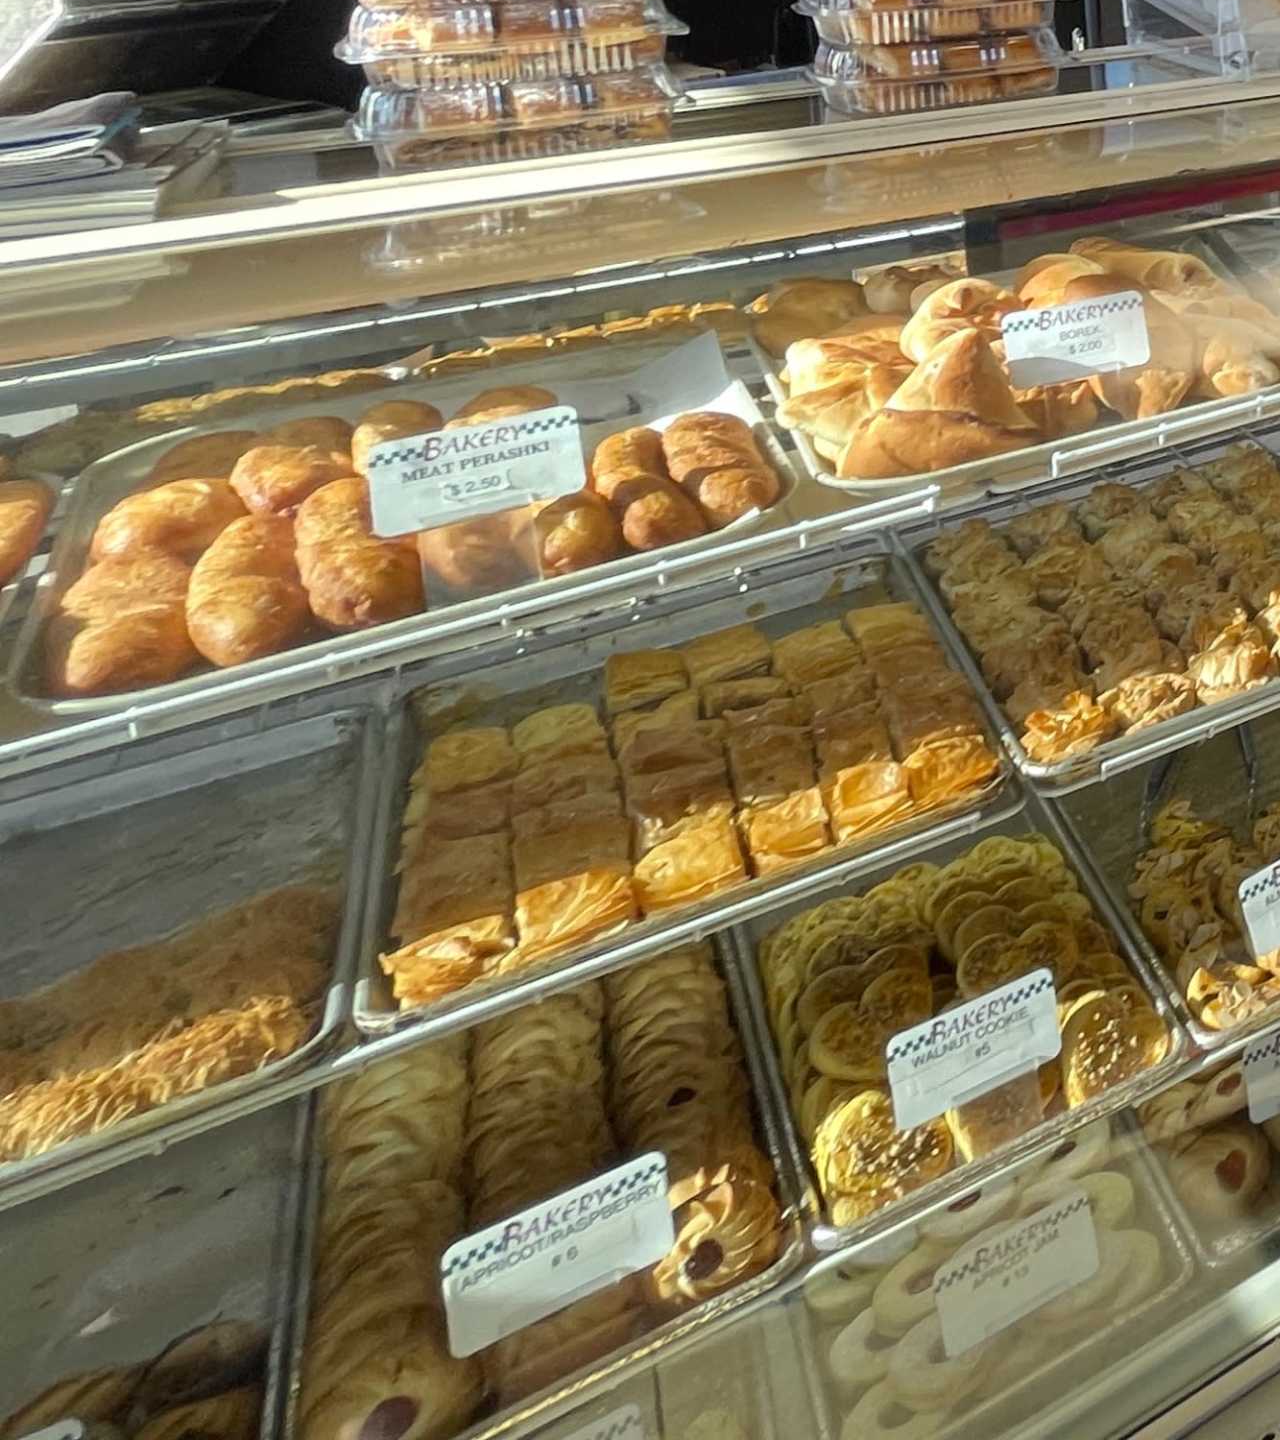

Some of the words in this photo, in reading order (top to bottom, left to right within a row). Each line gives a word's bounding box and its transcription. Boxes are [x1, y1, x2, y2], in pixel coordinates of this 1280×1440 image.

[1039, 303, 1106, 332] BAKERY
[401, 462, 455, 484] MEAT
[459, 440, 550, 471] PERASHKI
[424, 424, 523, 462] BAKERY
[911, 1032, 971, 1069] WALNUT
[974, 1006, 1031, 1039] COOKIE
[930, 994, 1009, 1044] BAKERY
[460, 1181, 661, 1292] APRICOT/RASPBERRY
[502, 1187, 610, 1250] BAKERY
[974, 1221, 1048, 1273] BAKERY
